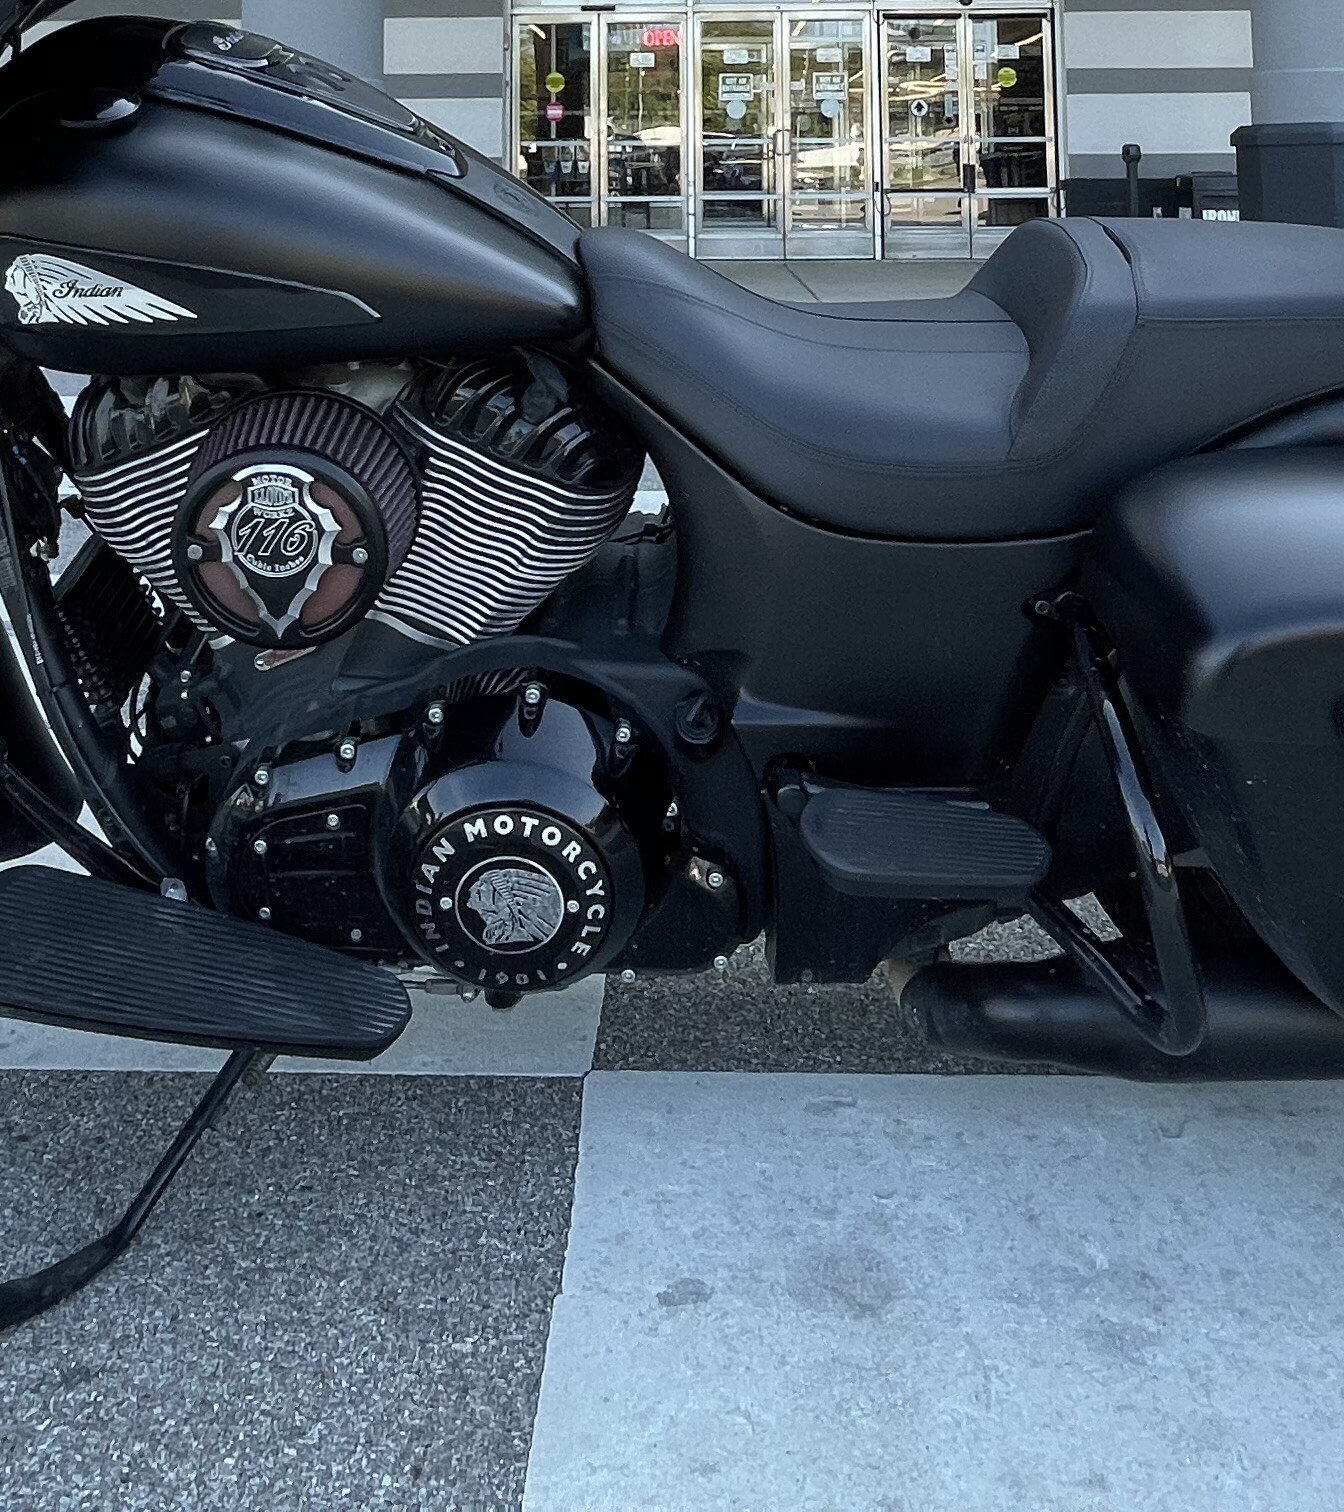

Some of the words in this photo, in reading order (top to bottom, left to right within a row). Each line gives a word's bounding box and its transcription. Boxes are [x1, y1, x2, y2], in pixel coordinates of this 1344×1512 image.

[643, 28, 681, 48] OPEN
[52, 279, 124, 299] Indian
[234, 518, 316, 556] 116
[414, 837, 456, 953] INDIAN
[462, 813, 607, 957] MOTORCYCLE
